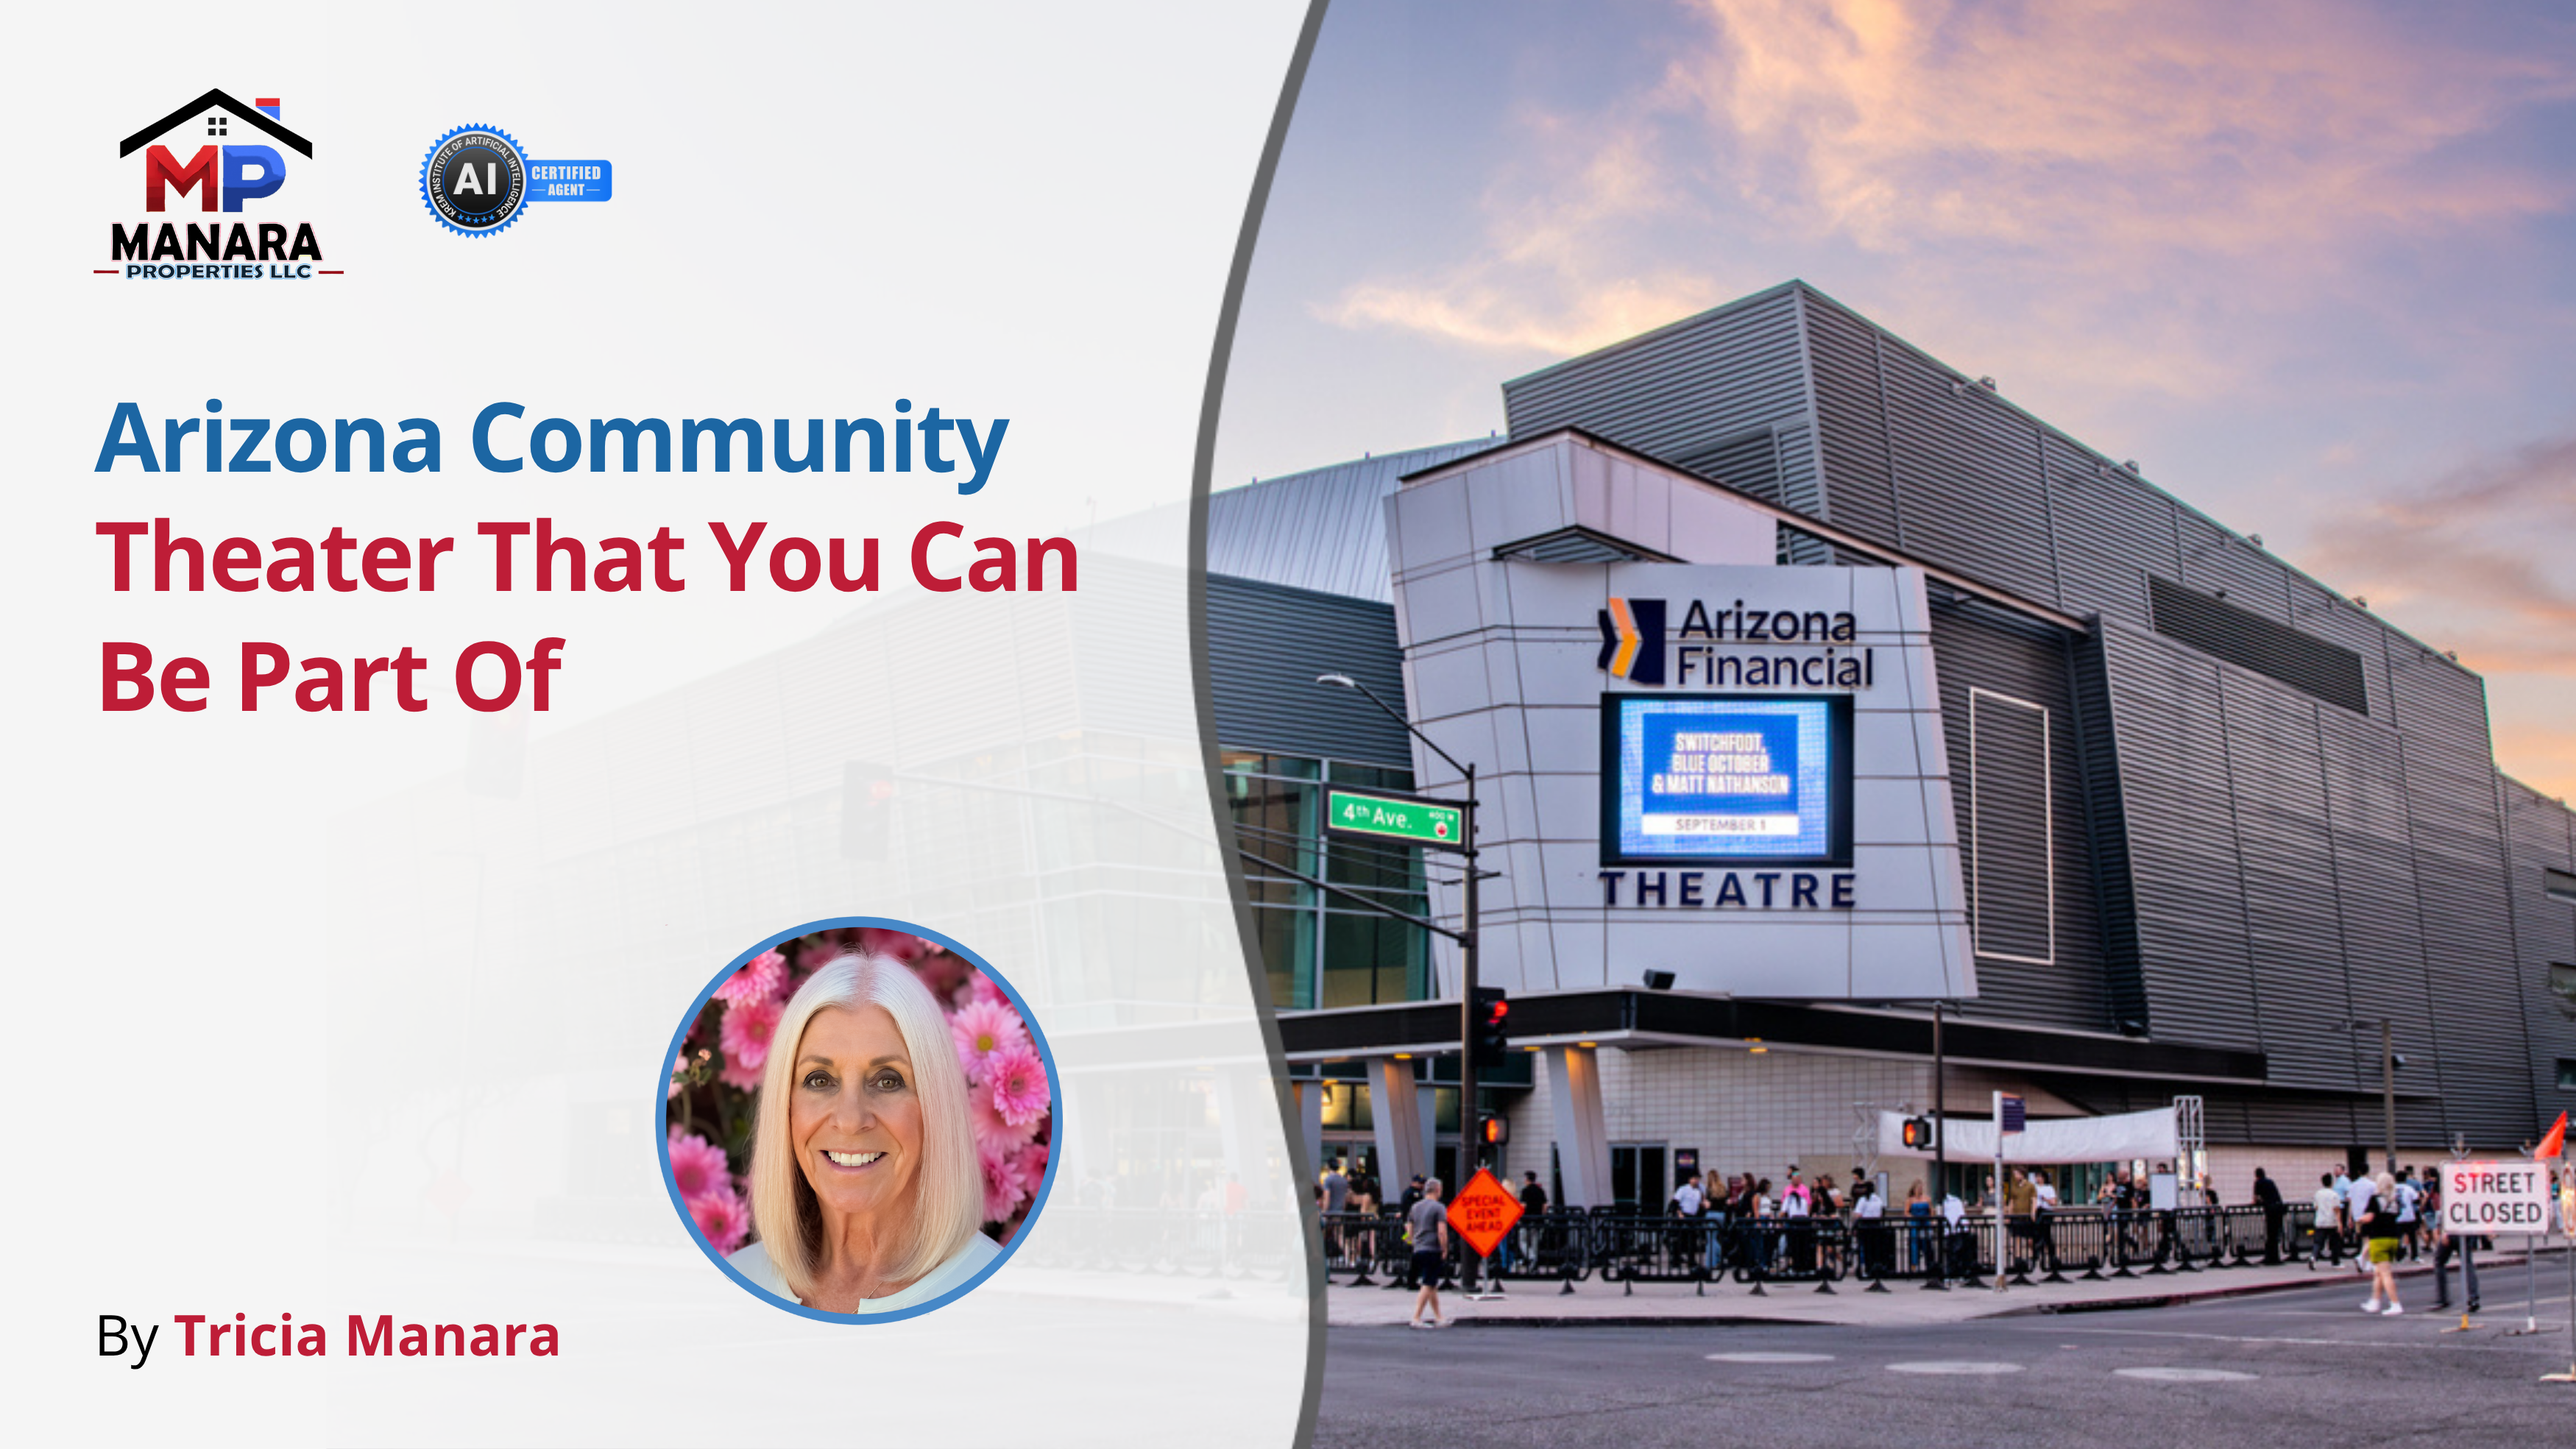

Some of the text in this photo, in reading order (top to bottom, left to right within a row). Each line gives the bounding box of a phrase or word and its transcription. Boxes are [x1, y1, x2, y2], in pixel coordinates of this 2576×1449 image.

[1679, 598, 1857, 642] Arizona
[1677, 646, 1873, 687] Financial
[1675, 732, 1766, 754] SWITCHFOOT,
[1672, 754, 1769, 772] BLUE OCTOBER
[1652, 774, 1788, 794] & MATT NATHANSON
[1343, 803, 1412, 829] 4th Ave.
[1675, 818, 1755, 831] SEPTEMBER
[1598, 871, 1856, 908] THEATRE
[2454, 1172, 2536, 1194] STREET
[1462, 1195, 1505, 1208] SPECIAL
[1466, 1208, 1501, 1219] EVENT
[2450, 1202, 2541, 1223] CLOSED
[1466, 1220, 1503, 1232] AHEAD
